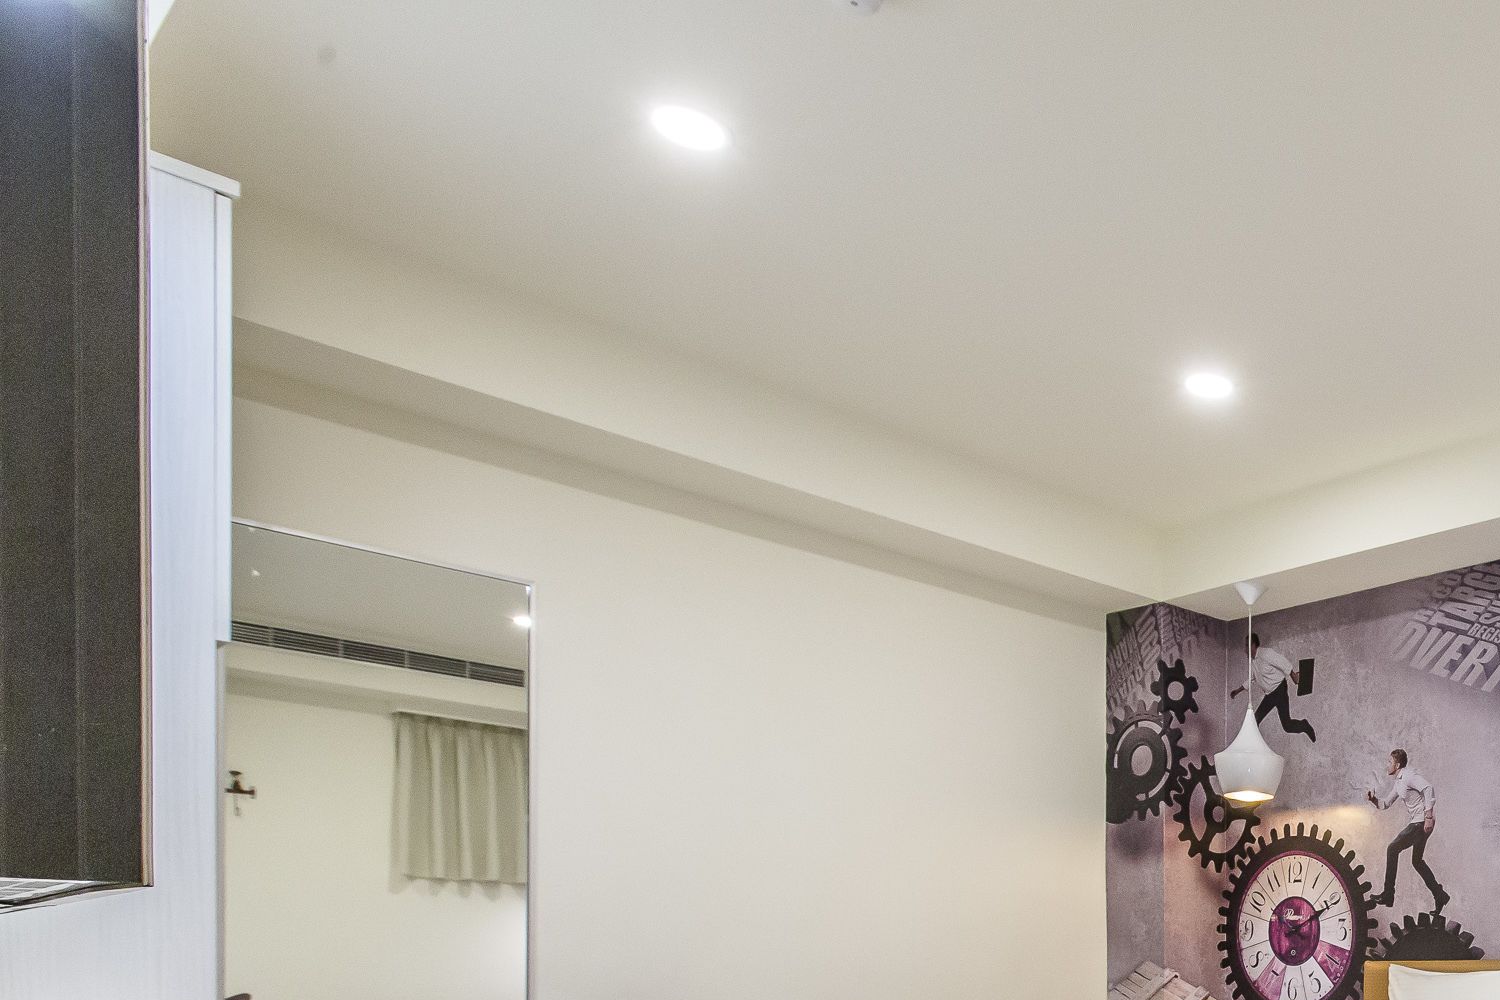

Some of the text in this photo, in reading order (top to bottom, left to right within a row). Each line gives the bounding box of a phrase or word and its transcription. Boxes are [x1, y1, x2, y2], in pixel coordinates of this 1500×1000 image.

[1287, 861, 1303, 884] 12
[1249, 891, 1266, 913] 10
[1287, 977, 1298, 1000] 6
